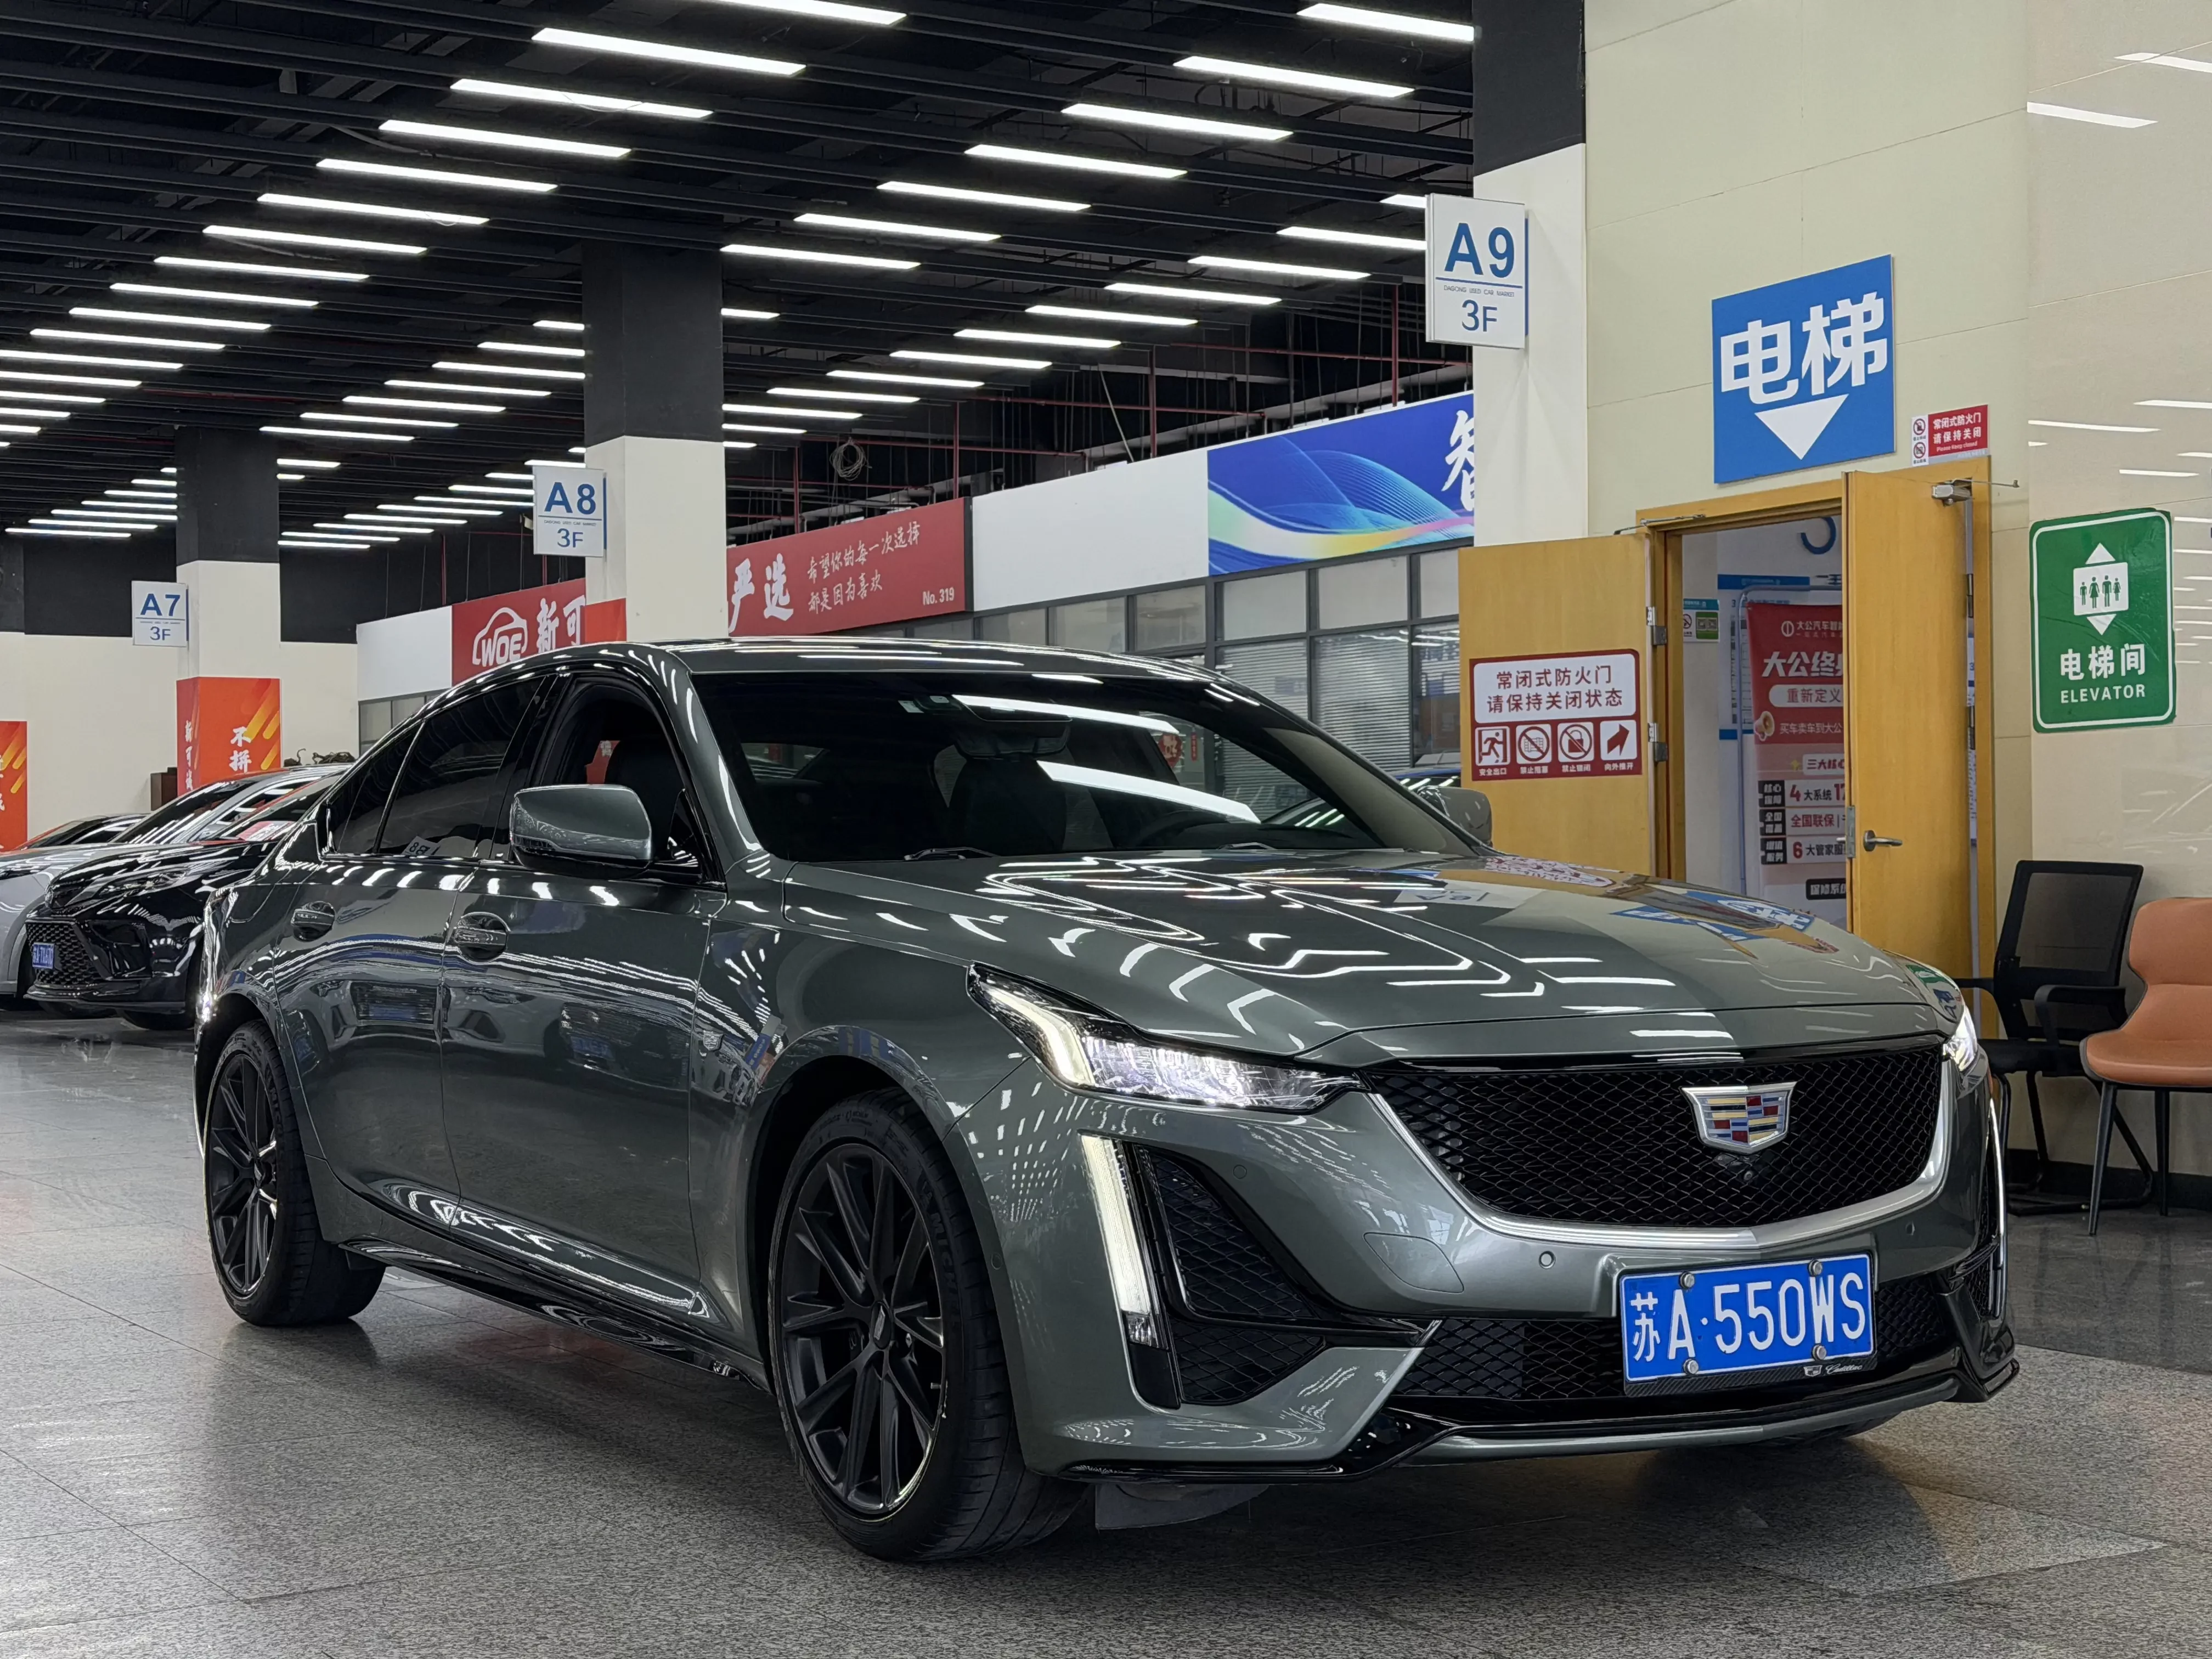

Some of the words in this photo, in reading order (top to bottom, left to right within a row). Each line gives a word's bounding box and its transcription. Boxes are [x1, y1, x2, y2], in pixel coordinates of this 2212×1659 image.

[1444, 223, 1515, 278] A9
[1462, 300, 1498, 331] 3F
[1721, 292, 1887, 403] 电梯
[1933, 412, 1982, 430] 常闭式防火门
[1933, 426, 1982, 444] 请保持关闭
[544, 482, 596, 515] A8
[557, 528, 583, 548] 3F
[807, 521, 921, 584] 希望你的每一次选择
[729, 553, 794, 633] 严选
[808, 569, 883, 614] 都是因为喜欢
[922, 590, 938, 606] No.
[939, 587, 955, 603] 319
[140, 594, 181, 616] A7
[150, 627, 171, 641] 3F
[537, 595, 585, 653] 新可
[2060, 643, 2145, 681] 电梯间
[1497, 665, 1612, 690] 常闭式防火门
[1487, 688, 1622, 713] 请保持关闭状态
[1787, 688, 1842, 703] 重新定义
[2061, 684, 2145, 703] ELEVATOR
[1780, 723, 1842, 735] 买车卖车到大公
[1479, 768, 1507, 777] 安全出口
[1791, 814, 1835, 828] 全国联保
[1792, 841, 1846, 859] 6大管家服
[1825, 1363, 1863, 1375] Cadillac
